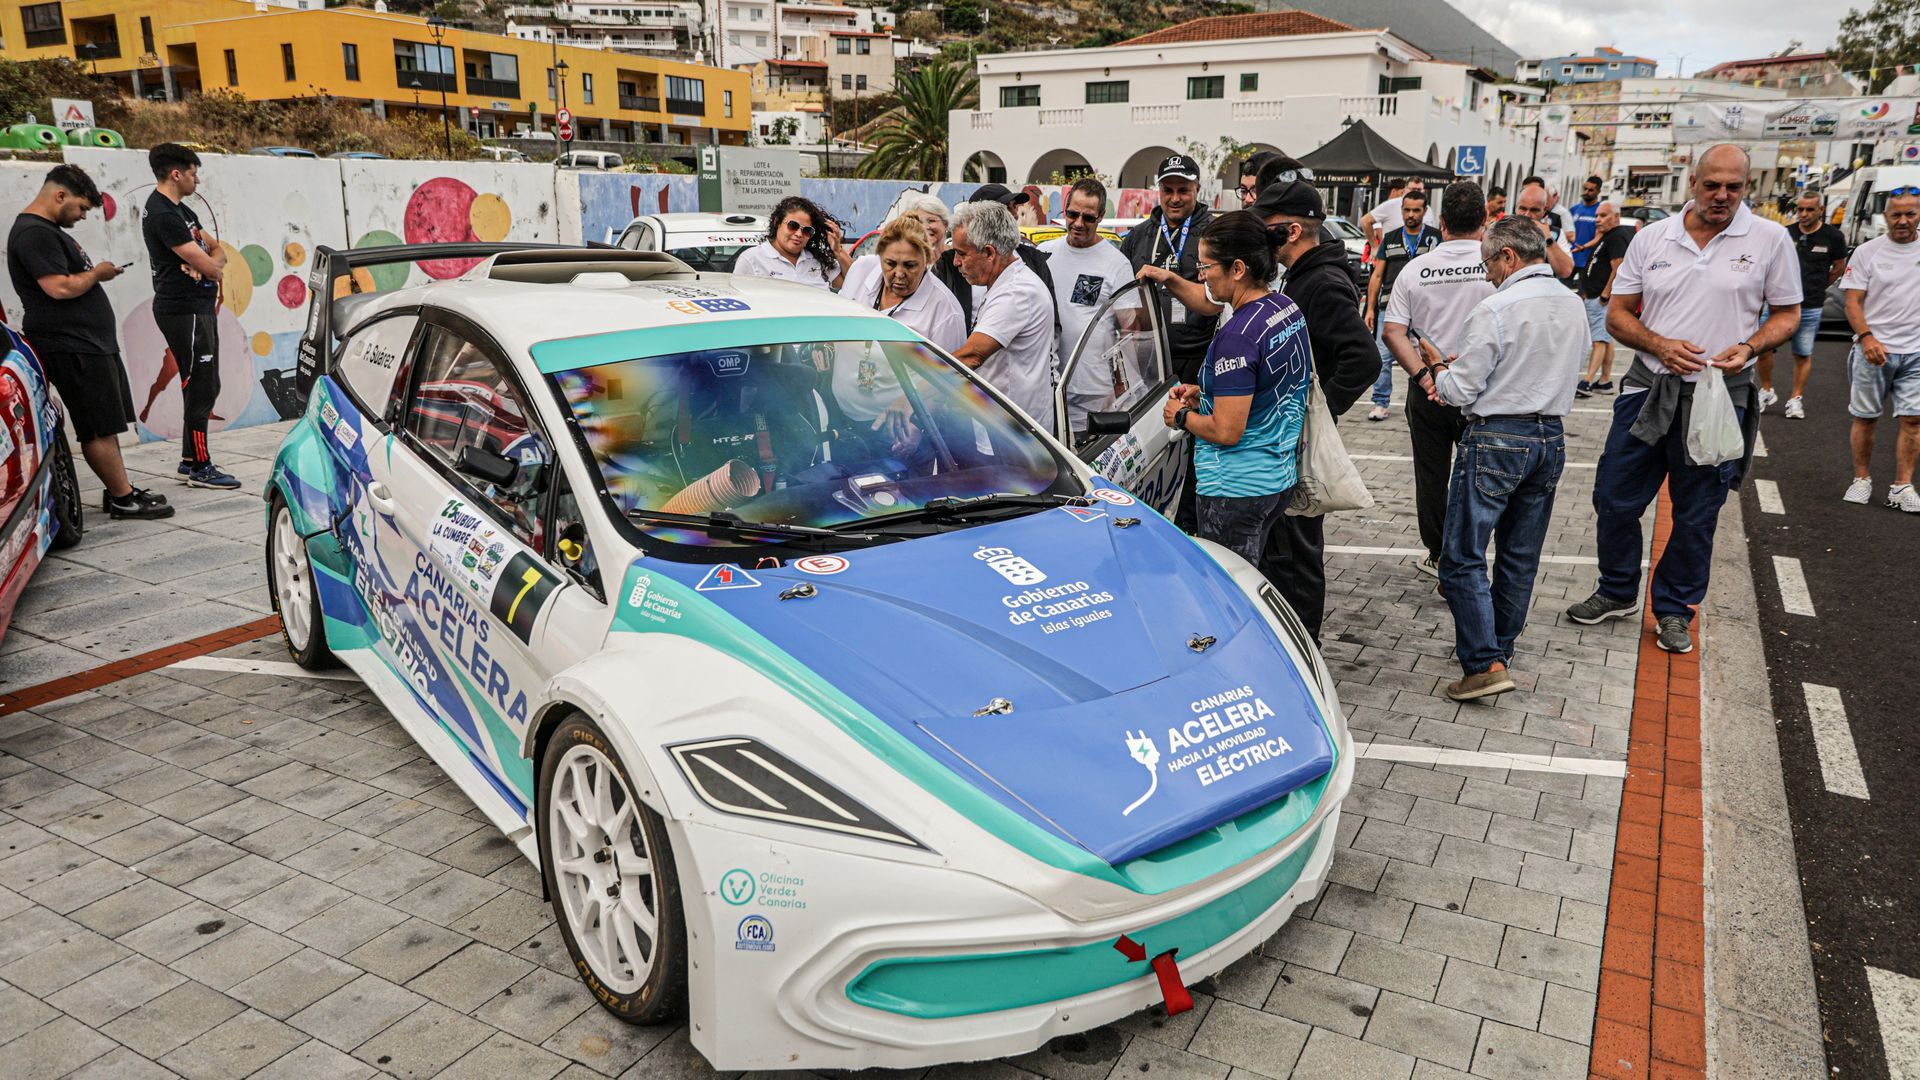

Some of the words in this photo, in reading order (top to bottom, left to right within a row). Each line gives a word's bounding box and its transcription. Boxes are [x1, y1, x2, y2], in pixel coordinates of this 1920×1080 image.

[370, 344, 395, 369] Suárez
[718, 357, 741, 368] OMP
[441, 500, 464, 518] 25
[451, 511, 482, 532] SUBIDA
[433, 523, 441, 535] LA
[442, 527, 472, 545] CUMBRE
[416, 551, 490, 643] CANARIAS
[507, 566, 543, 624] 7
[647, 591, 678, 608] Gobierno
[1002, 581, 1089, 608] Gobierno
[643, 600, 653, 608] de
[652, 602, 682, 619] Canarias
[1009, 610, 1036, 625] de
[1032, 591, 1114, 618] Canarias
[1040, 620, 1070, 634] islas
[1069, 609, 1113, 628] iguales
[404, 571, 528, 725] ACELERA
[1191, 685, 1254, 713] CANARIAS
[1168, 698, 1275, 754] ACELERA
[1168, 754, 1202, 773] HACIA
[1201, 746, 1218, 758] LA
[1217, 726, 1267, 752] MOVILIDAD
[1195, 736, 1293, 787] ELÉCTRICA
[760, 872, 805, 886] Oficinas
[760, 884, 797, 896] Verdes
[758, 896, 807, 909] Canarias
[747, 925, 764, 939] FCA
[577, 960, 619, 1008] ZERO
